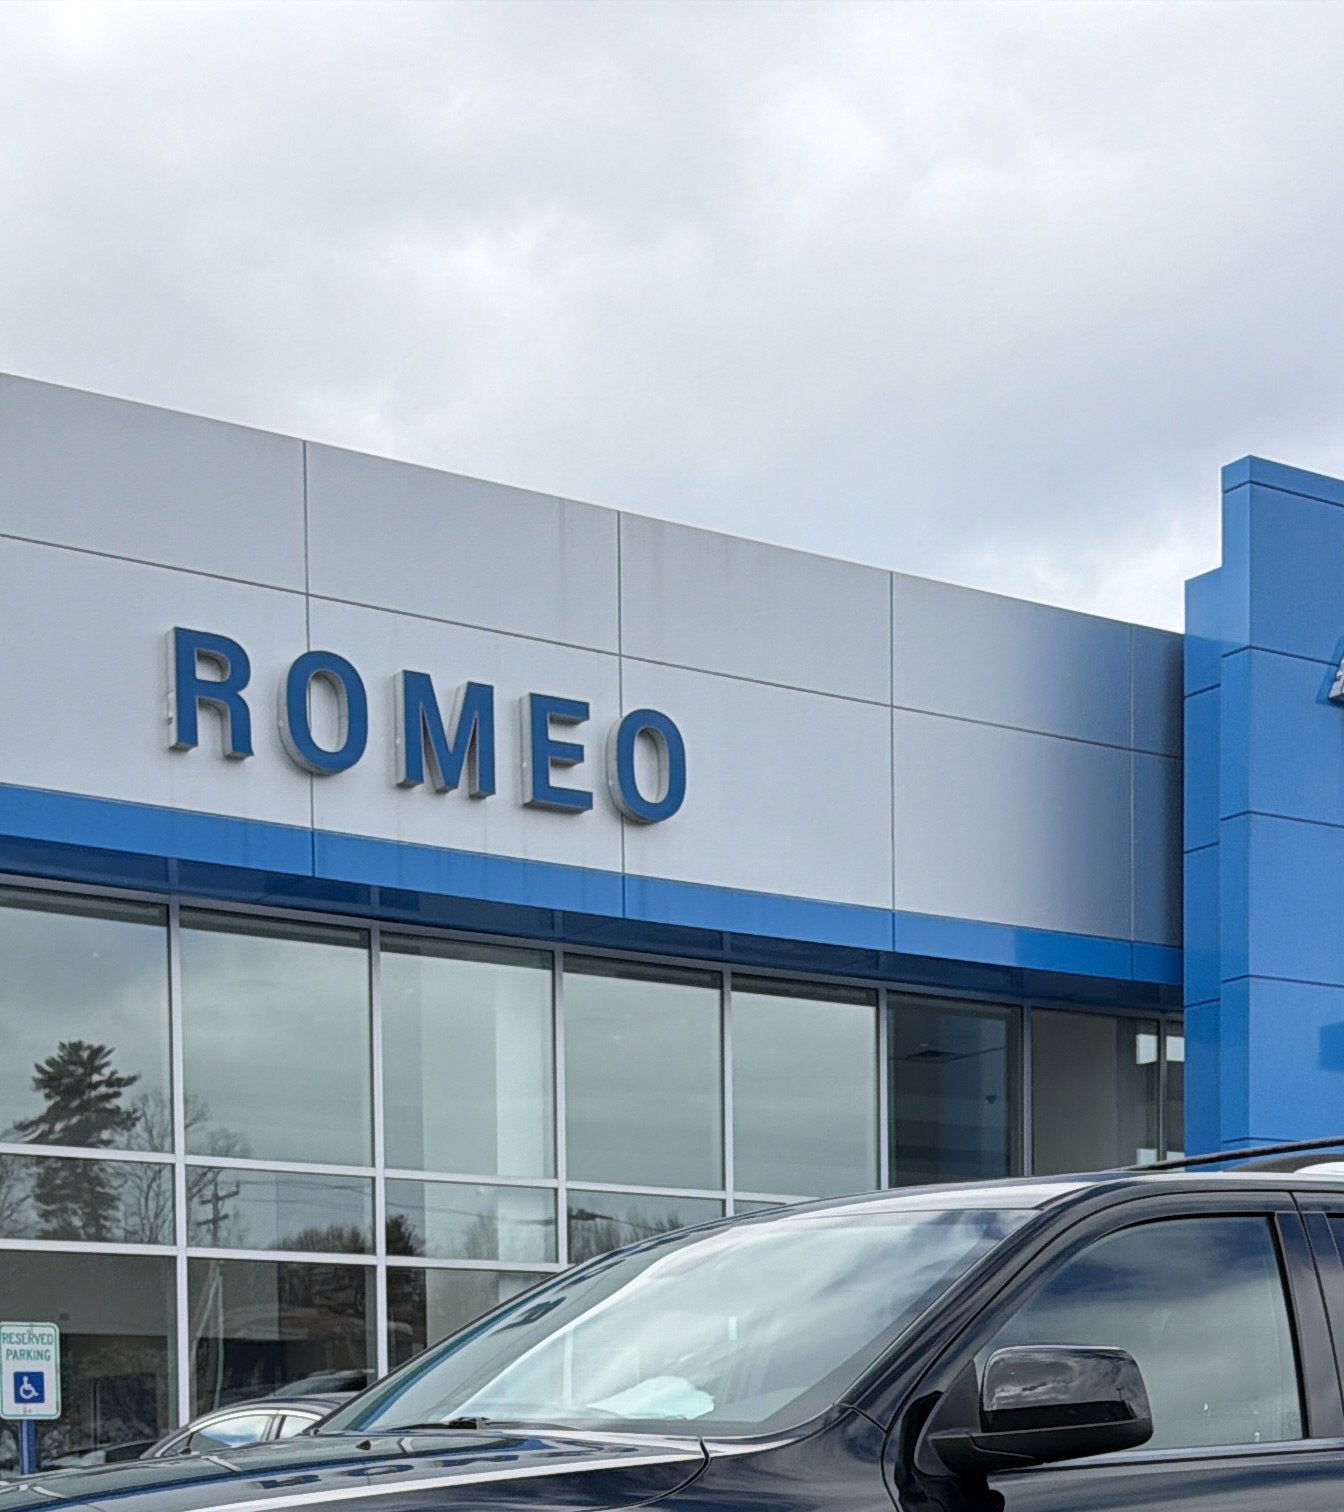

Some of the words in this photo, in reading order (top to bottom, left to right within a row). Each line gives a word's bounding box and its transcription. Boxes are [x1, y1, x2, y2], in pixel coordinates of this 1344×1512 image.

[167, 626, 687, 824] ROMEO
[1, 1332, 54, 1345] RESERVED
[5, 1348, 52, 1361] PARKING
